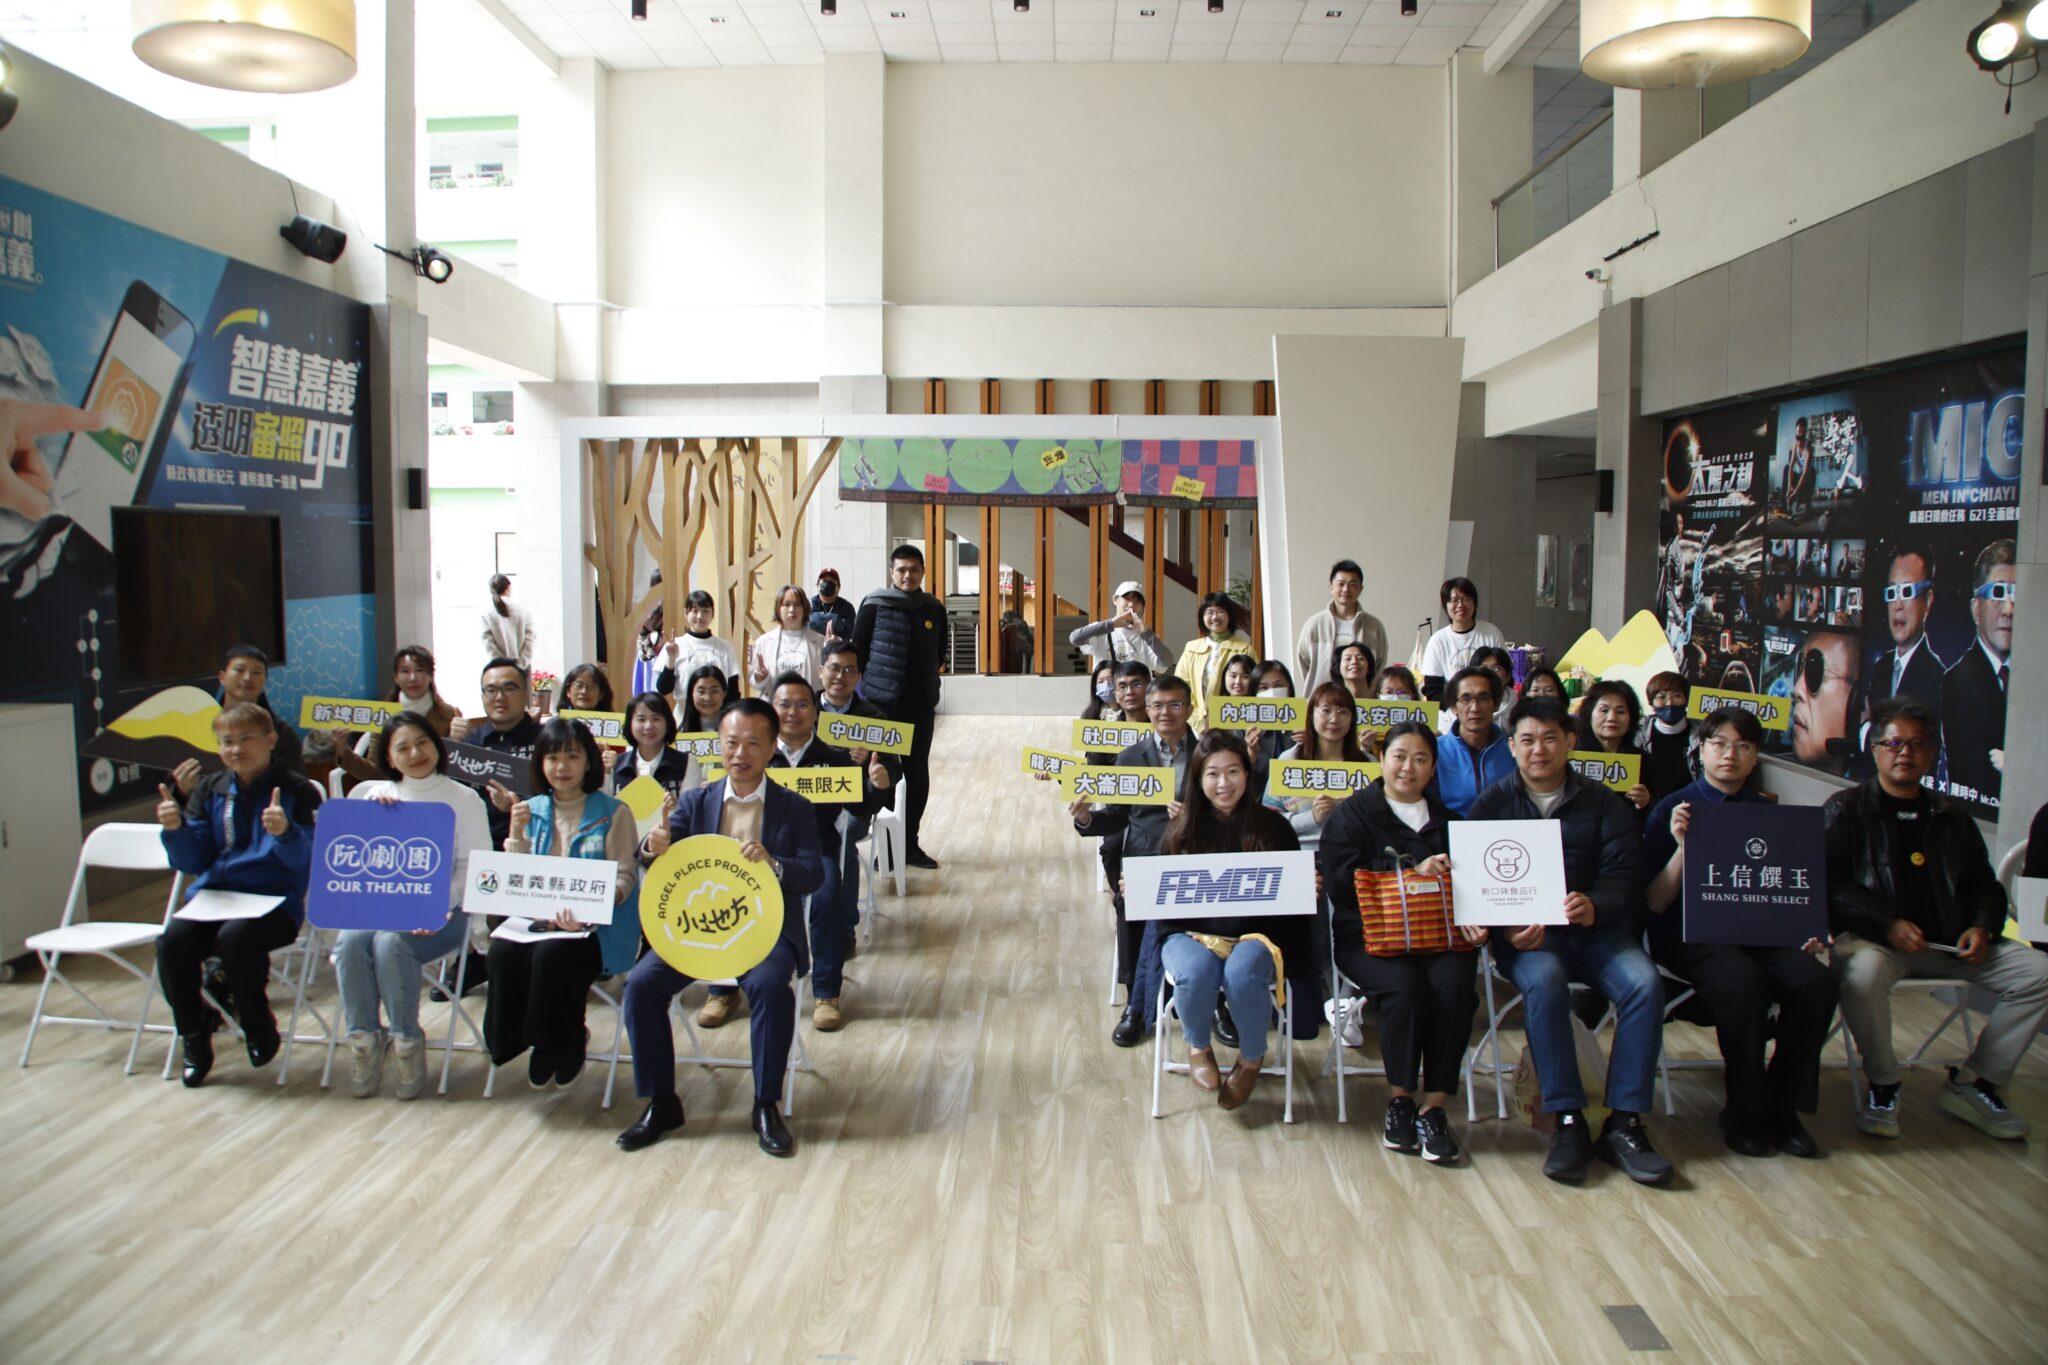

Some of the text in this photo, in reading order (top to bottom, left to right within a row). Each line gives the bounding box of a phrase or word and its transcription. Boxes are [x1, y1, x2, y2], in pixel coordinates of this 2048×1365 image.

[0, 235, 43, 284] 義。
[229, 334, 358, 416] 智慧嘉義
[1922, 486, 2016, 505] MEN IN CHIAYI
[312, 703, 391, 725] 新埤國小
[1220, 703, 1296, 724] 內埔國小
[829, 720, 902, 747] 中山國小
[1030, 752, 1087, 774] 龍港
[1283, 767, 1370, 791] 塭港國小
[332, 843, 432, 872] 阮劇團
[326, 879, 432, 895] OUR THEATRE
[508, 873, 607, 896] 嘉義縣政府
[1155, 866, 1284, 905] FEMCO
[1700, 863, 1810, 889] 上信饌玉
[505, 889, 604, 904] Chiayi County Government
[658, 858, 762, 919] ANGEL PLACE PROJECT
[1481, 886, 1537, 896] 新口味食品行
[1702, 892, 1810, 905] SHANG SHIN SELECT
